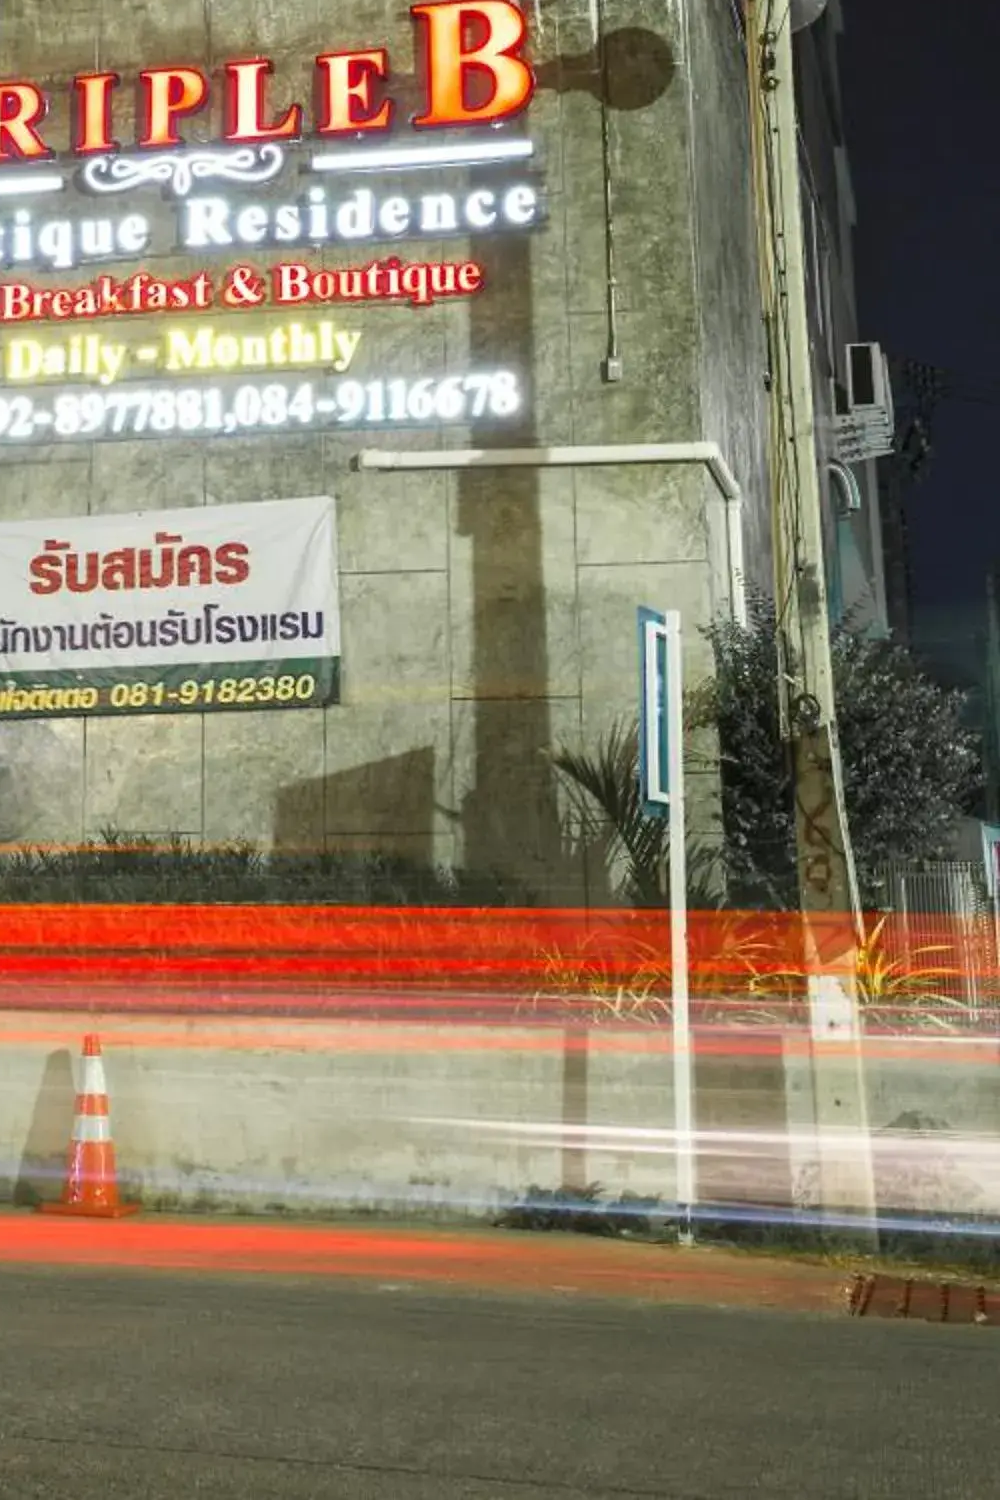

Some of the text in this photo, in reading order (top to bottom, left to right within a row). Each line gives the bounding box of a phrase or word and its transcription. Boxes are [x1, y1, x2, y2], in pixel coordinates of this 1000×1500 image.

[186, 185, 538, 247] Residence
[1, 270, 212, 320] Breakfast
[224, 264, 265, 304] &
[277, 257, 483, 305] Boutique
[6, 333, 126, 385] Daily
[166, 321, 363, 372] Monthly
[29, 531, 250, 596] รับสมัคร
[111, 674, 316, 708] 081-9182380
